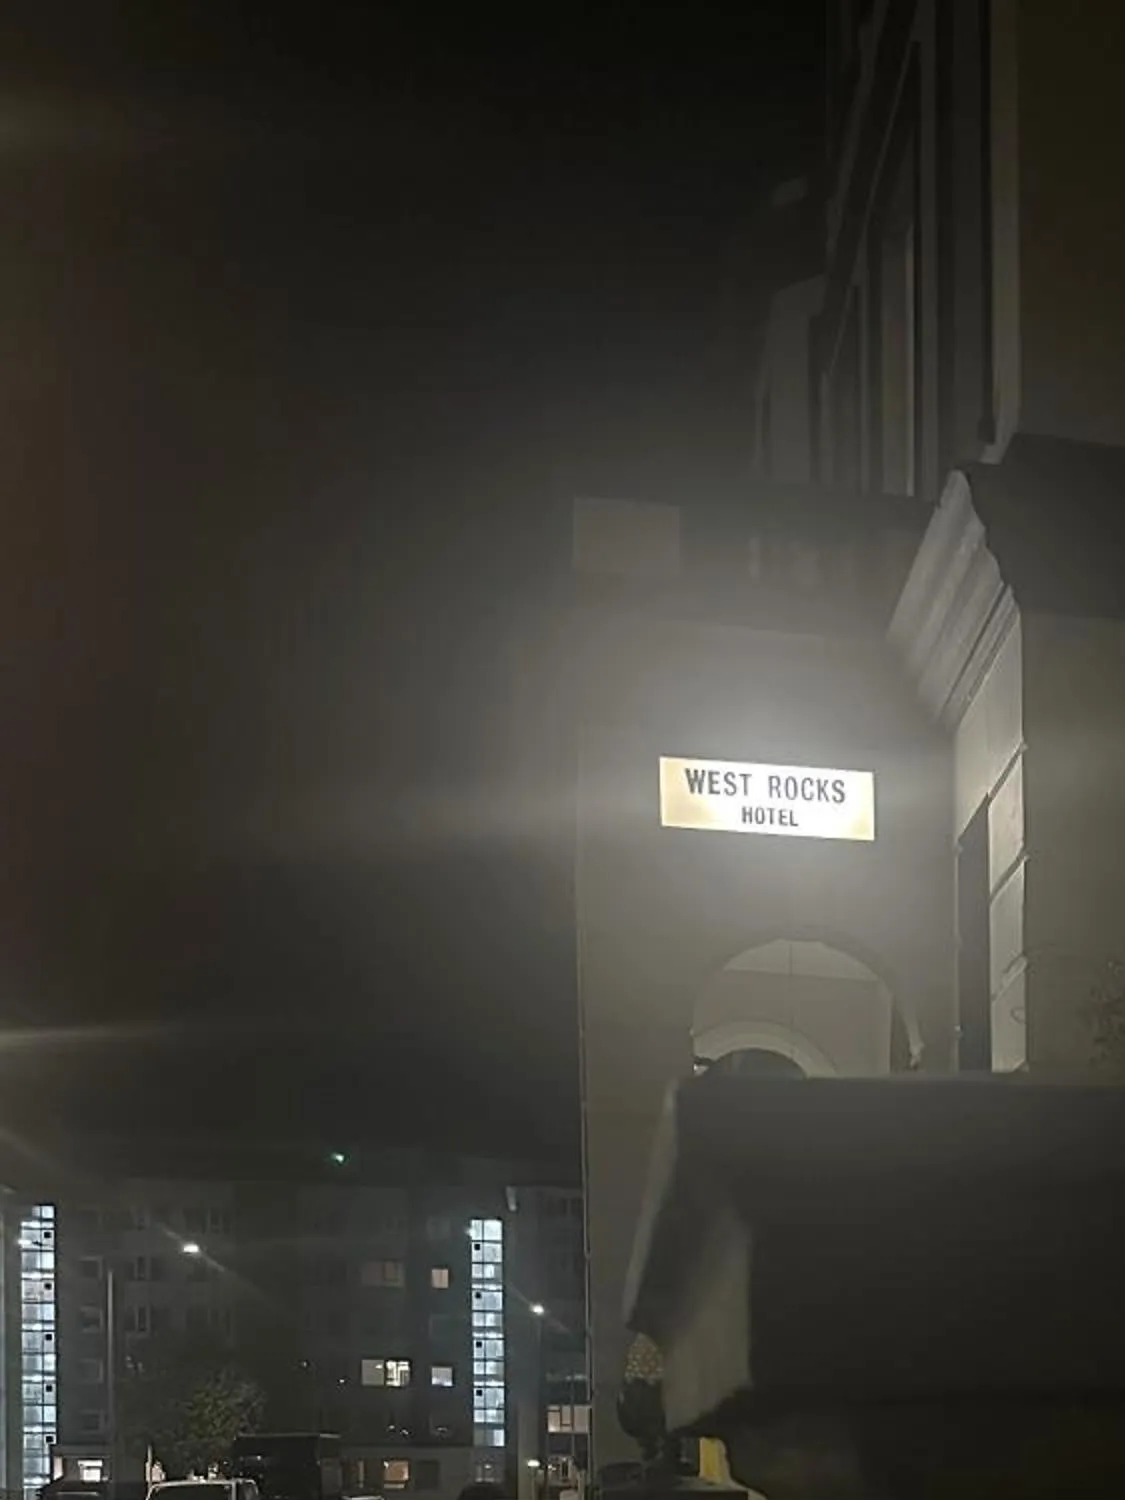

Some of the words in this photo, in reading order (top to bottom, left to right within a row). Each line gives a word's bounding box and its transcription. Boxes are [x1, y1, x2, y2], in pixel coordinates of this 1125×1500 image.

[685, 768, 752, 796] WEST
[767, 775, 845, 804] ROCKS
[741, 806, 798, 827] HOTEL
